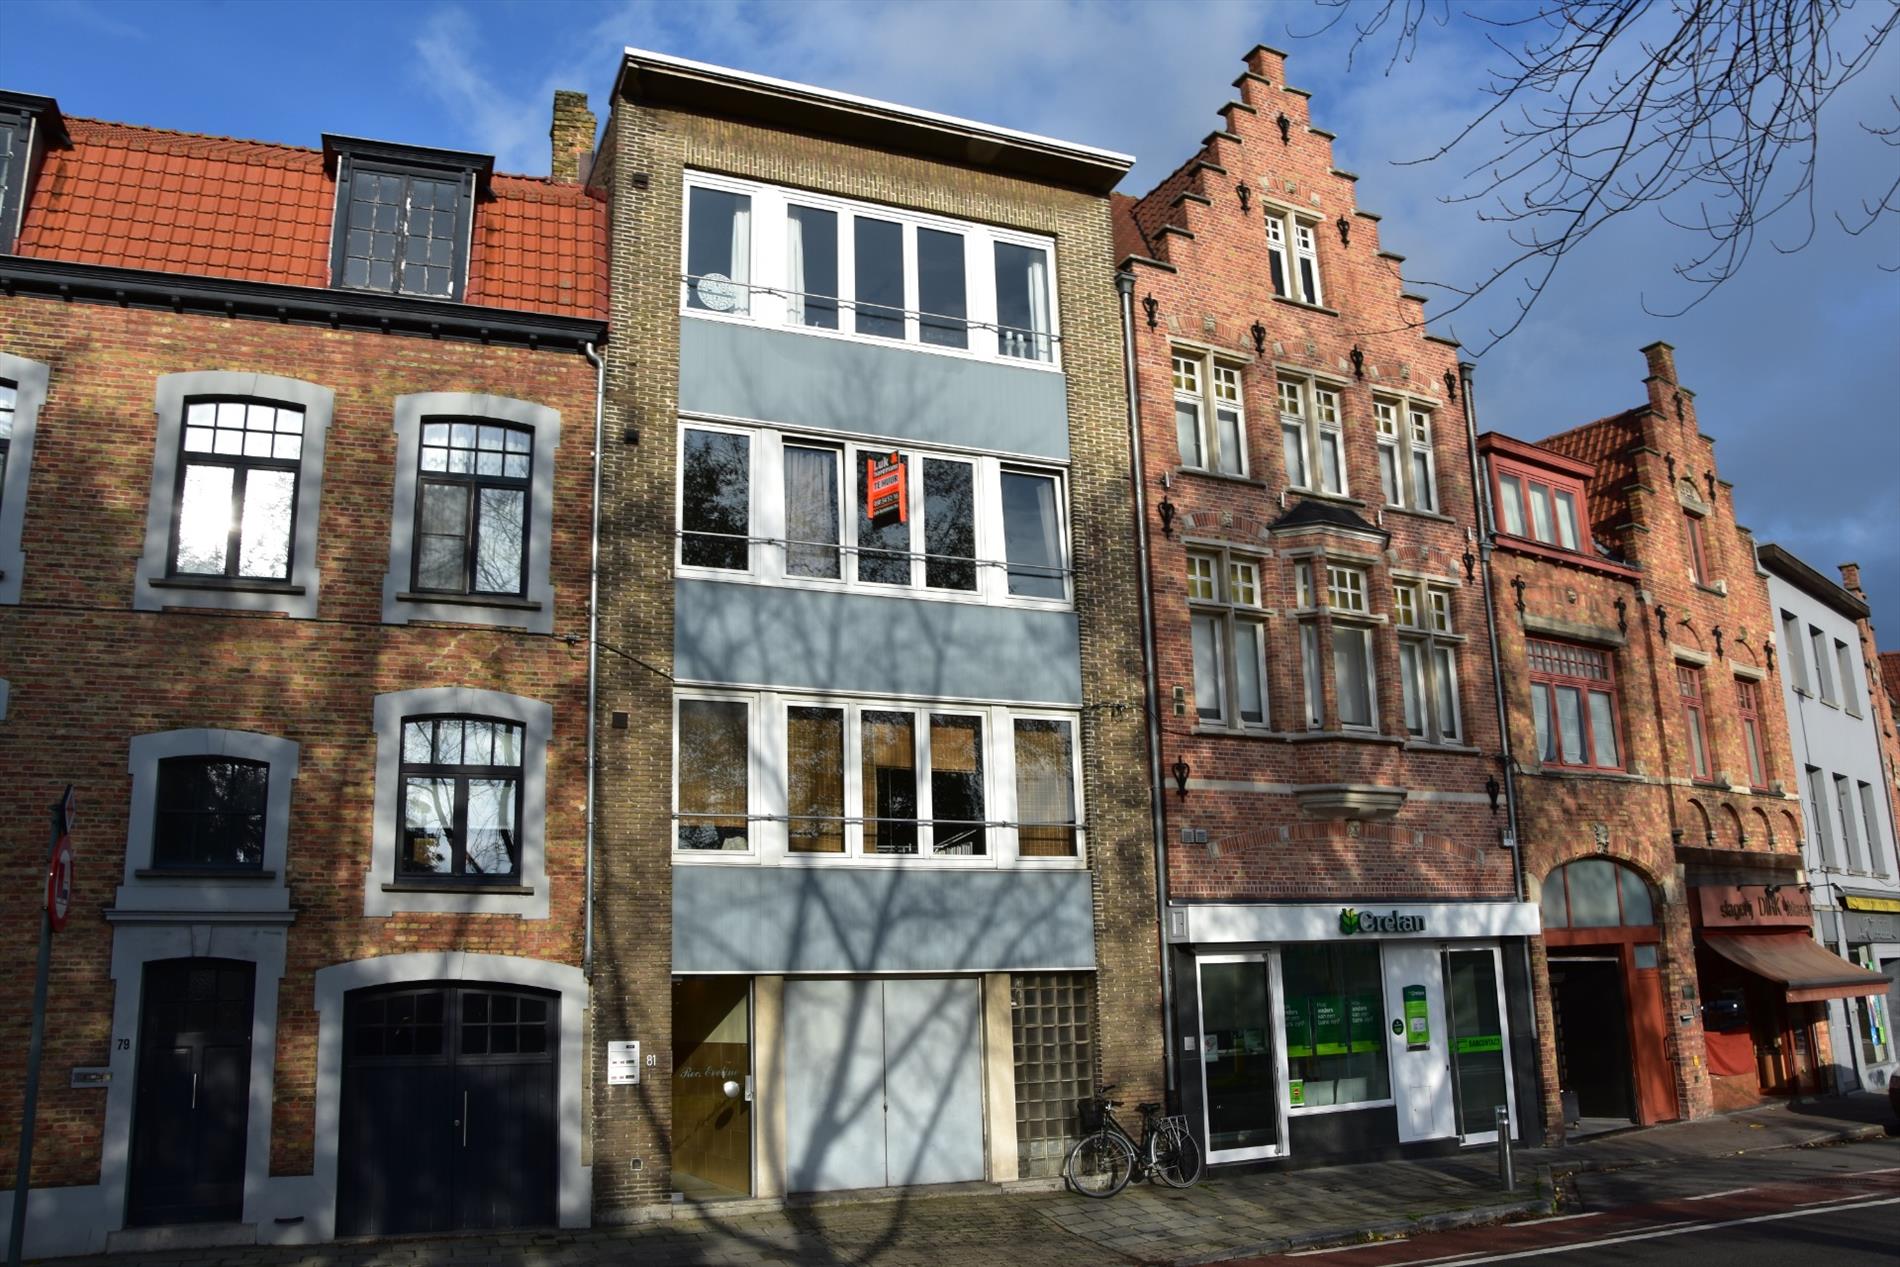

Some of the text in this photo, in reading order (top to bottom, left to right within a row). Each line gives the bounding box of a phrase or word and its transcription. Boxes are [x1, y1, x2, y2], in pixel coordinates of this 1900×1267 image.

[874, 482, 880, 490] TE
[1358, 910, 1426, 932] Crelan
[117, 1038, 130, 1050] 79
[646, 1054, 656, 1066] 81
